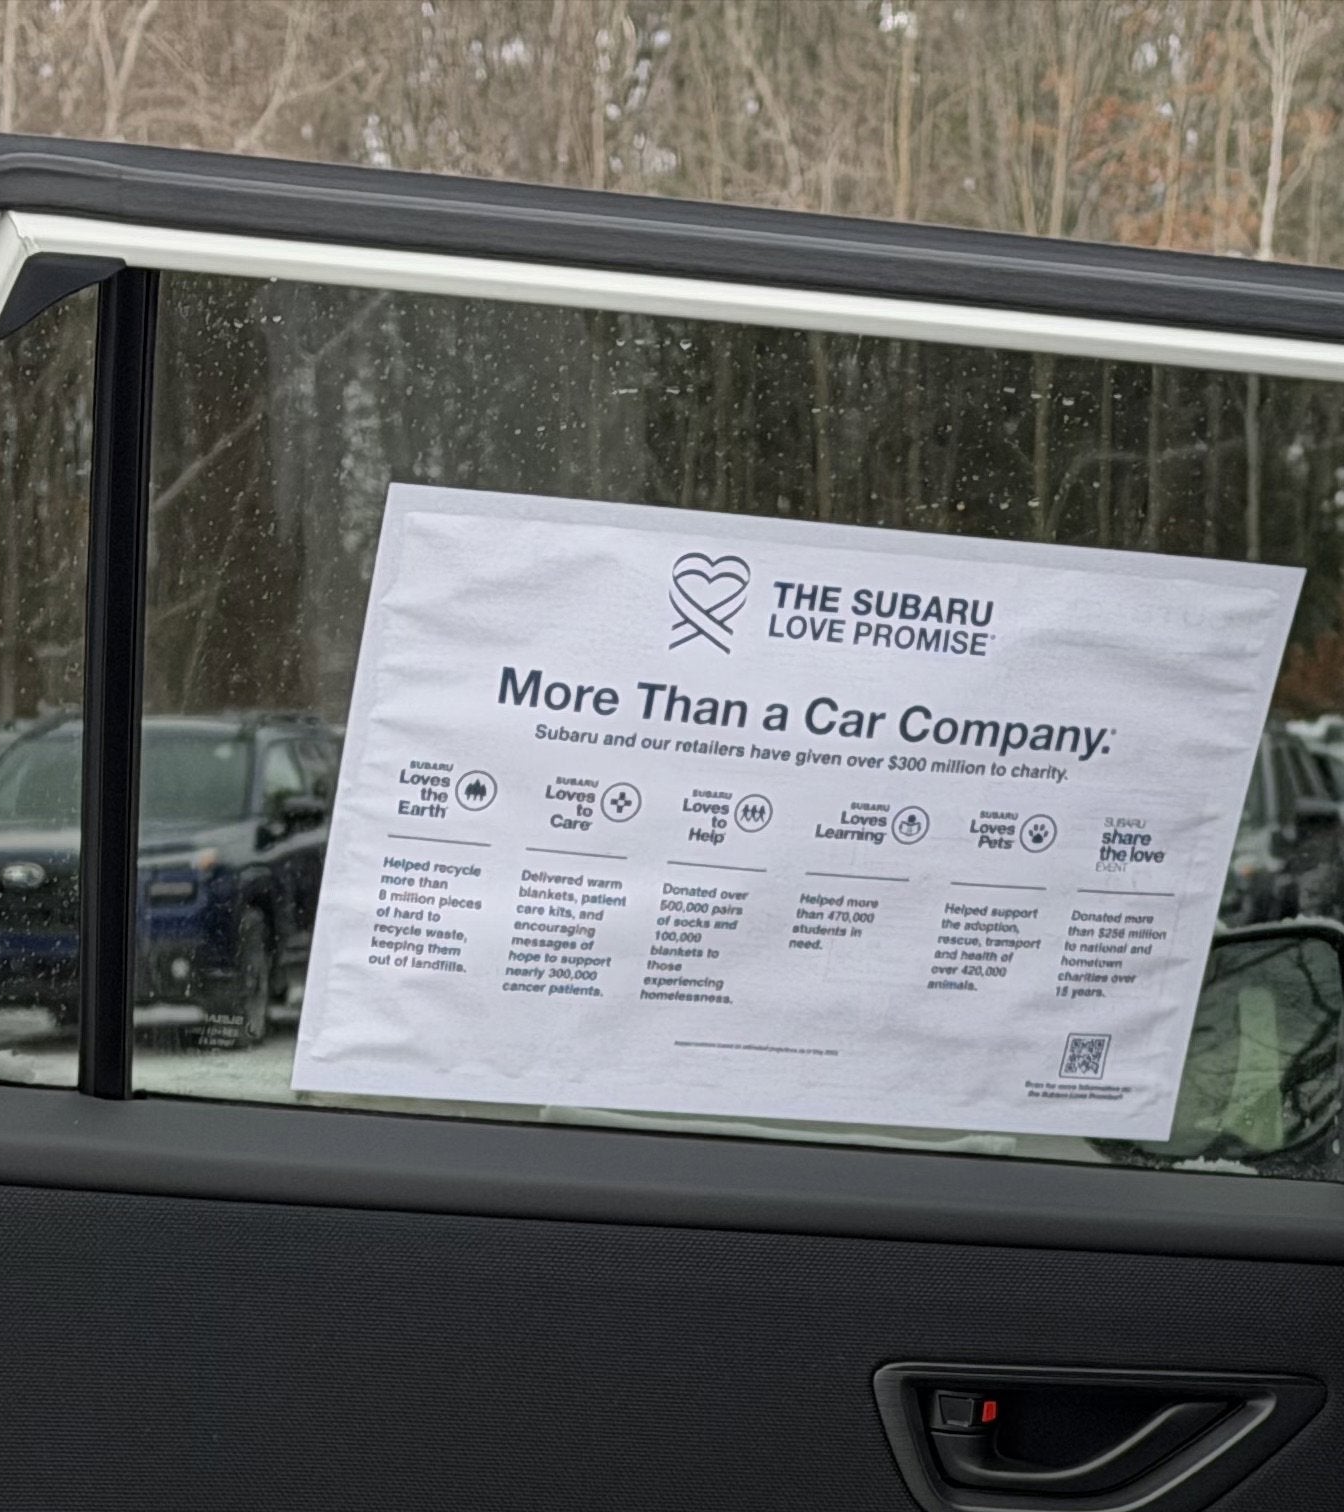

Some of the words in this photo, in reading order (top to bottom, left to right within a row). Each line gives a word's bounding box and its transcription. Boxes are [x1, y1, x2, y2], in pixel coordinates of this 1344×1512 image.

[774, 582, 842, 613] THE
[851, 589, 993, 627] SUBARU
[769, 614, 846, 643] LOVE
[498, 666, 619, 716] More
[637, 682, 748, 728] Than
[763, 702, 788, 731] a
[805, 696, 886, 738] Car
[535, 723, 598, 744] Subaru
[603, 732, 637, 748] and
[641, 738, 671, 750] our
[675, 739, 745, 758] retailers
[750, 744, 791, 761] have
[795, 750, 842, 767] given
[847, 754, 884, 769] over
[888, 755, 926, 772] $300
[931, 760, 985, 776] million
[991, 763, 1006, 776] to
[1010, 764, 1068, 783] charity.
[399, 769, 451, 788] Loves
[420, 788, 448, 803] the
[546, 785, 596, 802] Loves
[398, 800, 446, 819] Earth
[576, 804, 594, 818] to
[682, 800, 730, 814] Loves
[550, 814, 592, 831] Care
[712, 816, 727, 829] to
[840, 811, 887, 827] Loves
[815, 824, 886, 844] Learning
[970, 819, 1015, 836] Loves
[688, 828, 725, 846] Help
[978, 836, 1014, 850] Pets
[1102, 828, 1152, 846] share
[1100, 846, 1127, 861] the
[1130, 846, 1164, 863] love
[384, 856, 430, 872] Helped
[434, 860, 482, 877] recycle
[380, 874, 415, 887] more
[418, 877, 448, 890] than
[522, 870, 584, 886] Delivered
[587, 879, 622, 890] warm
[519, 886, 578, 904] blankets,
[581, 892, 626, 907] patient
[663, 882, 716, 899] Donated
[720, 890, 748, 900] over
[390, 892, 435, 905] million
[439, 896, 482, 910] pieces
[800, 893, 844, 908] Helped
[846, 898, 879, 909] more
[376, 906, 390, 918] of
[394, 908, 423, 921] hard
[427, 910, 440, 922] to
[516, 904, 545, 916] care
[548, 906, 576, 920] kits,
[579, 910, 604, 921] and
[712, 904, 743, 917] pairs
[796, 908, 824, 921] than
[945, 903, 988, 918] Helped
[991, 908, 1038, 920] support
[1072, 910, 1122, 924] Donated
[1124, 914, 1154, 924] more
[514, 920, 596, 938] encouraging
[656, 916, 670, 926] of
[674, 916, 710, 929] socks
[714, 919, 738, 930] and
[792, 924, 846, 937] students
[850, 927, 862, 938] in
[942, 918, 962, 930] the
[374, 922, 422, 939] recycle
[426, 928, 468, 943] waste,
[1068, 926, 1095, 938] than
[1128, 928, 1167, 940] million
[371, 936, 424, 954] keeping
[428, 943, 461, 956] them
[512, 936, 576, 951] messages
[580, 940, 594, 950] of
[789, 939, 823, 950] need.
[938, 934, 982, 948] rescue,
[986, 937, 1042, 950] transport
[1065, 941, 1076, 952] to
[1080, 943, 1126, 954] national
[1130, 944, 1152, 955] and
[508, 951, 540, 964] hope
[545, 952, 557, 963] to
[561, 956, 612, 969] support
[650, 945, 704, 958] blankets
[707, 948, 719, 960] to
[934, 950, 957, 960] and
[960, 950, 997, 962] health
[1000, 952, 1014, 963] of
[368, 954, 391, 966] out
[394, 956, 408, 968] of
[647, 960, 682, 971] those
[1061, 956, 1122, 969] hometown
[506, 966, 545, 980] nearly
[931, 964, 958, 976] over
[1058, 971, 1108, 982] charities
[1112, 973, 1136, 984] over
[503, 981, 546, 992] cancer
[548, 983, 604, 998] patients.
[643, 976, 724, 990] experiencing
[927, 979, 978, 991] animals.
